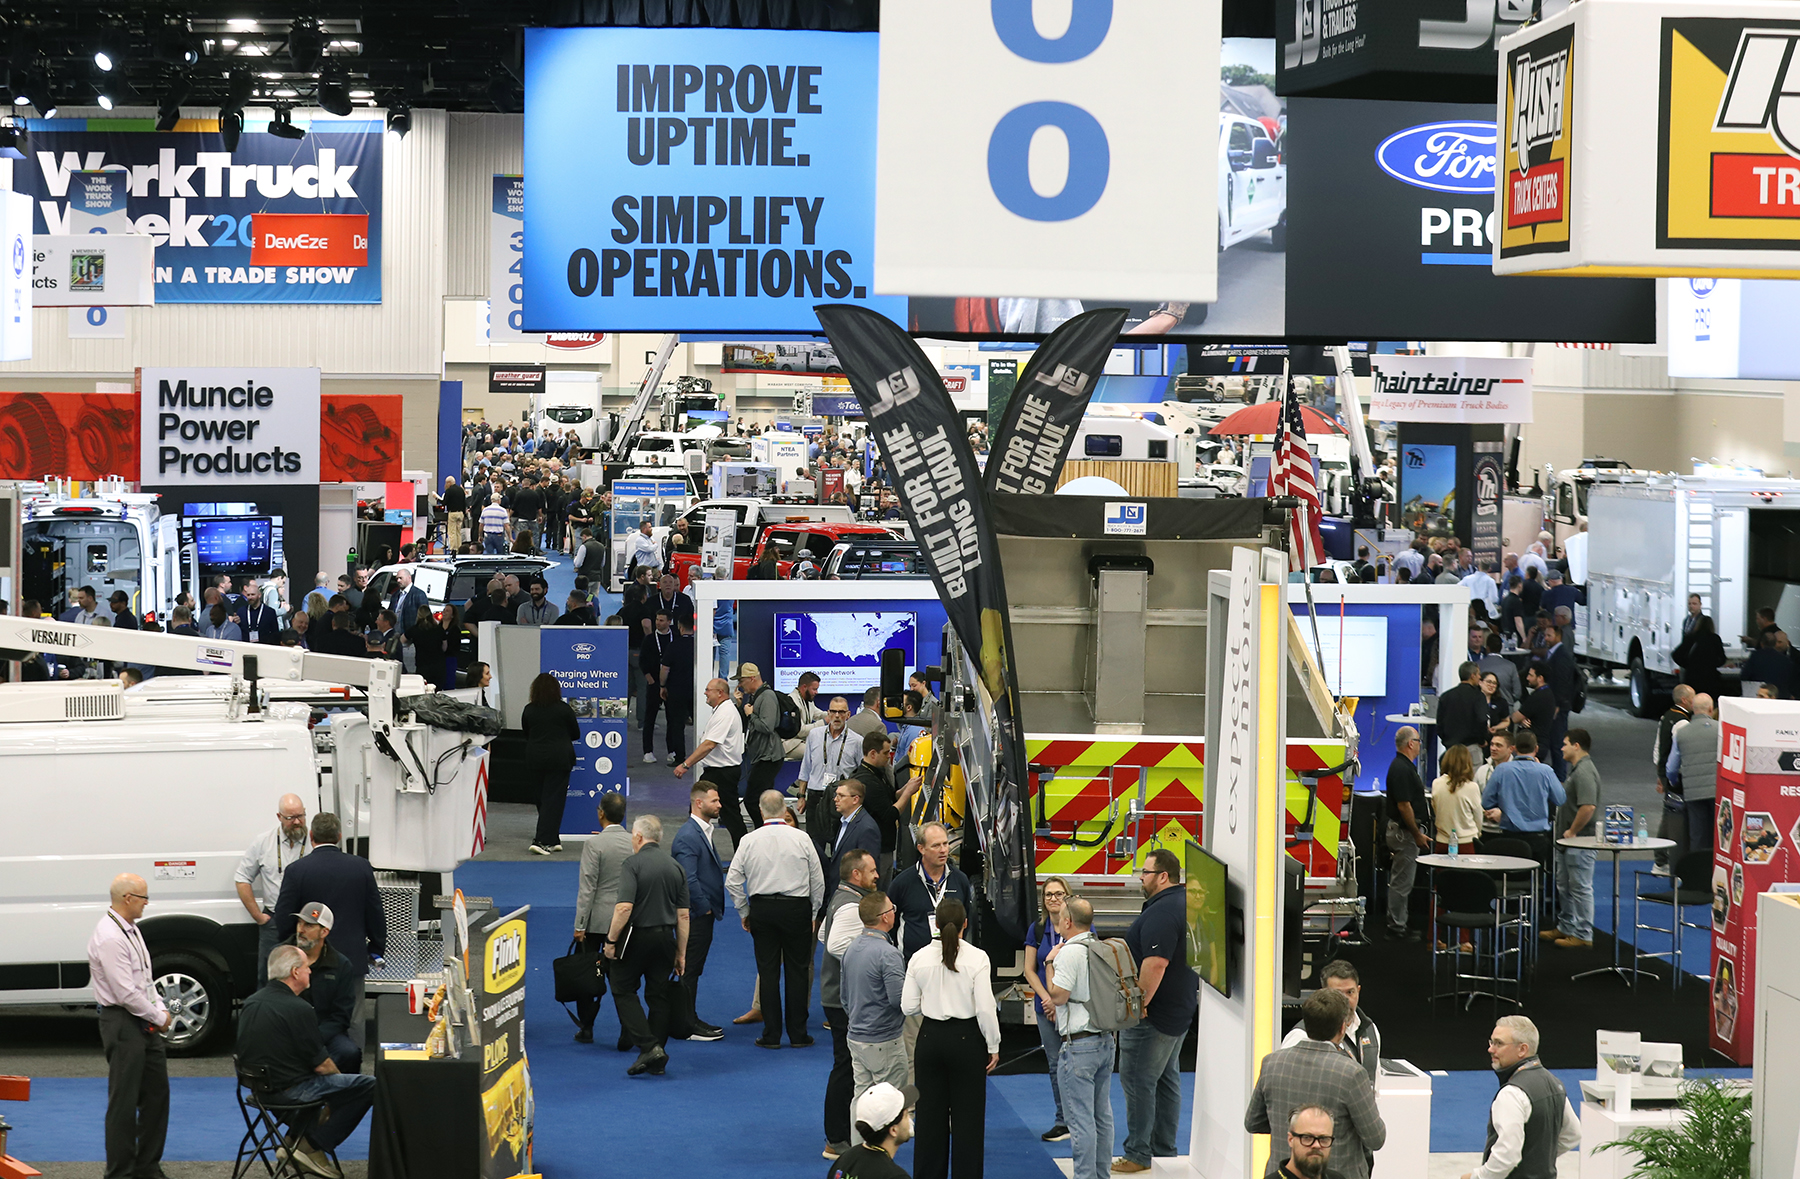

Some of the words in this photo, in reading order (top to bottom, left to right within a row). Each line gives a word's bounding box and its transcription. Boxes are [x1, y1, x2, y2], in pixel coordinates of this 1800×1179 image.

[1328, 4, 1358, 38] TRAILERS
[616, 64, 822, 114] IMPROVE
[627, 117, 810, 166] UPTIME.
[1414, 132, 1497, 178] For
[1513, 176, 1532, 215] TRUCK
[1532, 172, 1558, 212] CENTERS
[611, 195, 824, 245] SIMPLIFY
[1421, 207, 1494, 246] PR
[181, 267, 198, 283] A
[205, 267, 277, 283] TRADE
[567, 248, 866, 298] OPERATIONS.
[158, 379, 274, 408] Muncie
[1015, 393, 1051, 436] THE
[1385, 399, 1407, 410] Legacy
[1408, 399, 1418, 410] of
[1417, 401, 1457, 409] Premium
[1460, 400, 1484, 409] Truck
[1485, 400, 1509, 409] Bodies
[158, 413, 260, 441] Power
[158, 446, 301, 474] Products
[883, 422, 923, 478] THE
[999, 435, 1035, 481] FOR
[904, 472, 947, 529] FOR
[948, 498, 982, 573] LONG
[923, 528, 968, 600] BUILT
[31, 629, 77, 648] VERSALIFT
[1240, 565, 1252, 732] more.
[549, 669, 588, 680] Charging
[589, 670, 618, 679] Where
[576, 681, 600, 689] Need
[601, 681, 609, 689] It
[1228, 636, 1242, 835] expect
[492, 928, 521, 979] Flink
[1715, 936, 1738, 958] QUALITY
[484, 1032, 509, 1068] PLOWS
